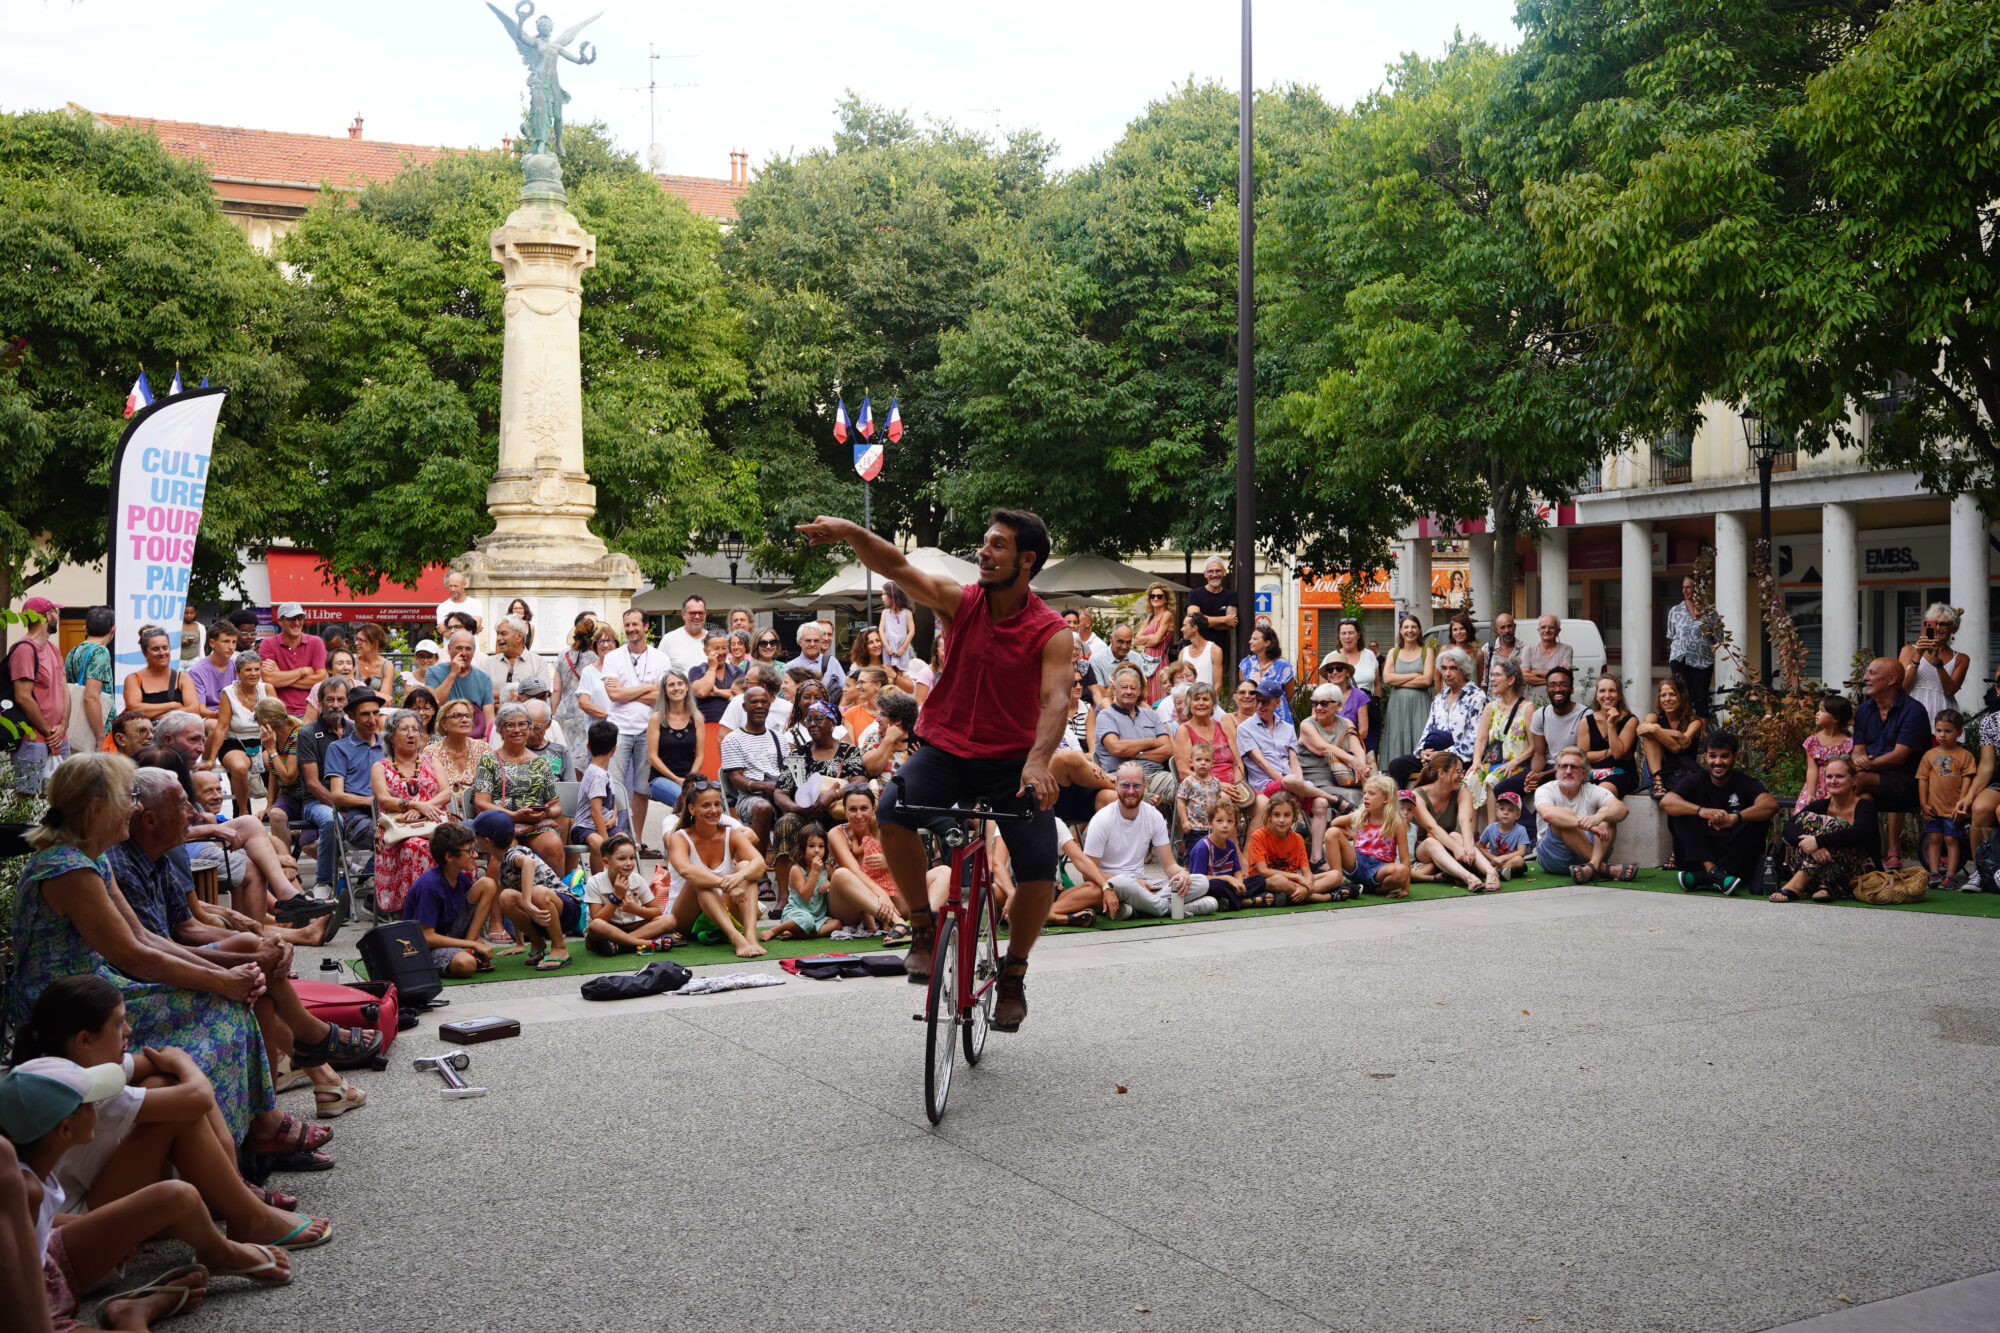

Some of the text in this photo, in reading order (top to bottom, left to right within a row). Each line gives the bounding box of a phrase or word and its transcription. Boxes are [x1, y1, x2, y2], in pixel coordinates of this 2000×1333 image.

[142, 447, 211, 480] CULT
[151, 477, 206, 508] URE
[127, 504, 201, 537] POUR
[129, 534, 195, 565] TOUS
[1866, 546, 1912, 565] EMBS
[146, 565, 191, 593] PAR
[130, 594, 187, 621] TOUT
[312, 609, 343, 620] Libre
